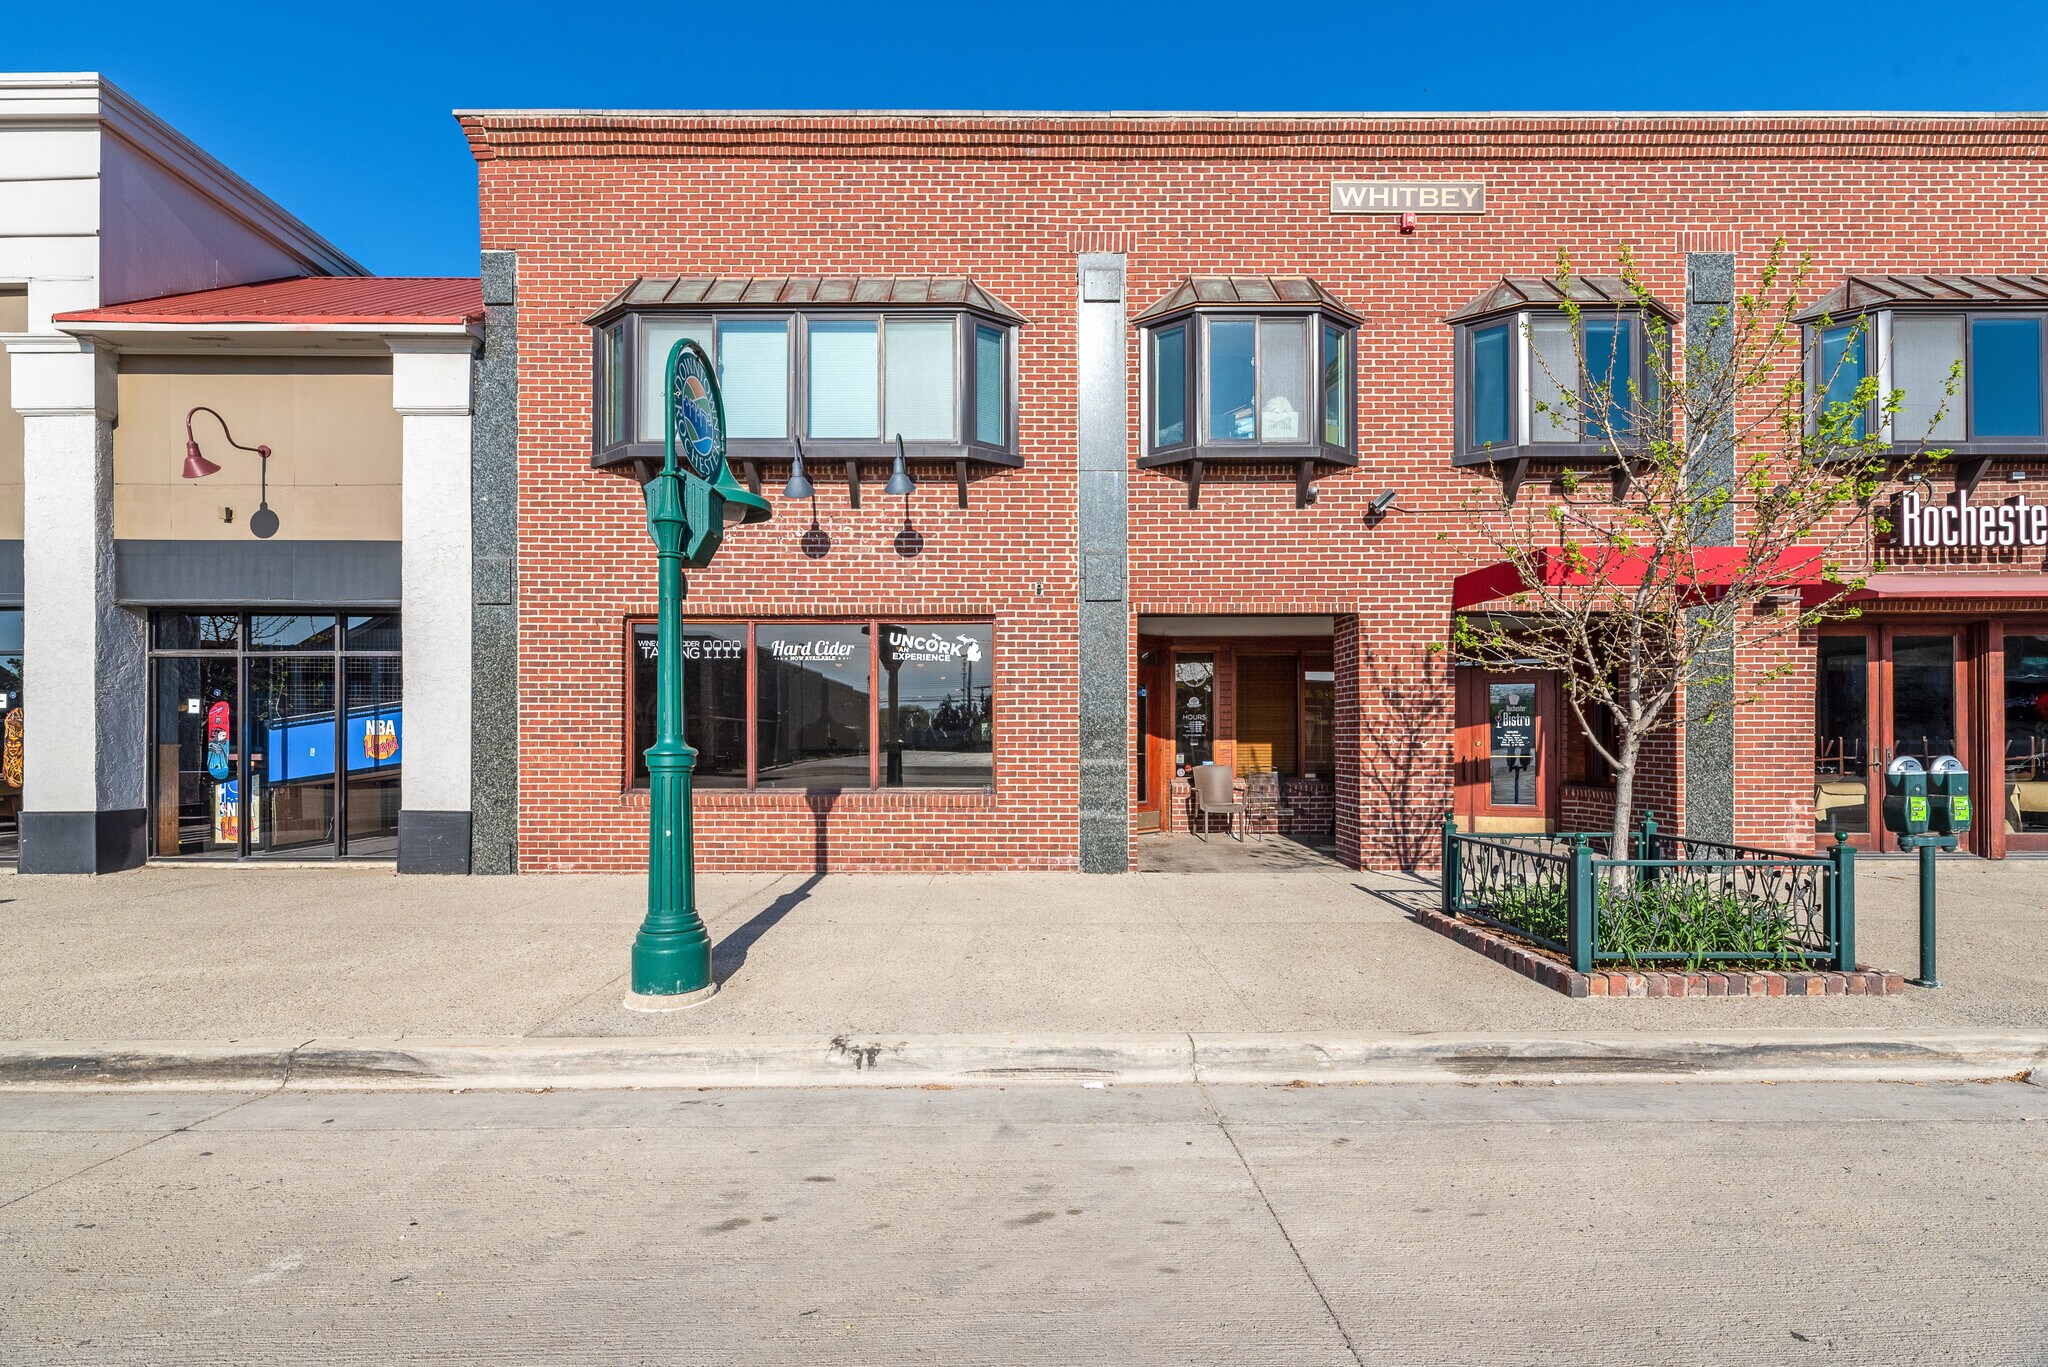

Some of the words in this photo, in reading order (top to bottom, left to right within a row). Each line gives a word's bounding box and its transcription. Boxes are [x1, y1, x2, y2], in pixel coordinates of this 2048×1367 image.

[1337, 187, 1480, 207] WHITBEY
[675, 357, 722, 433] DOWNTOWN
[675, 403, 721, 478] ROCHESTER
[771, 640, 812, 656] Hard
[815, 640, 855, 656] Cider
[889, 632, 963, 657] UNCORK
[892, 652, 951, 661] EXPERIENCE
[366, 720, 396, 736] NBA
[1503, 712, 1530, 726] Bistro
